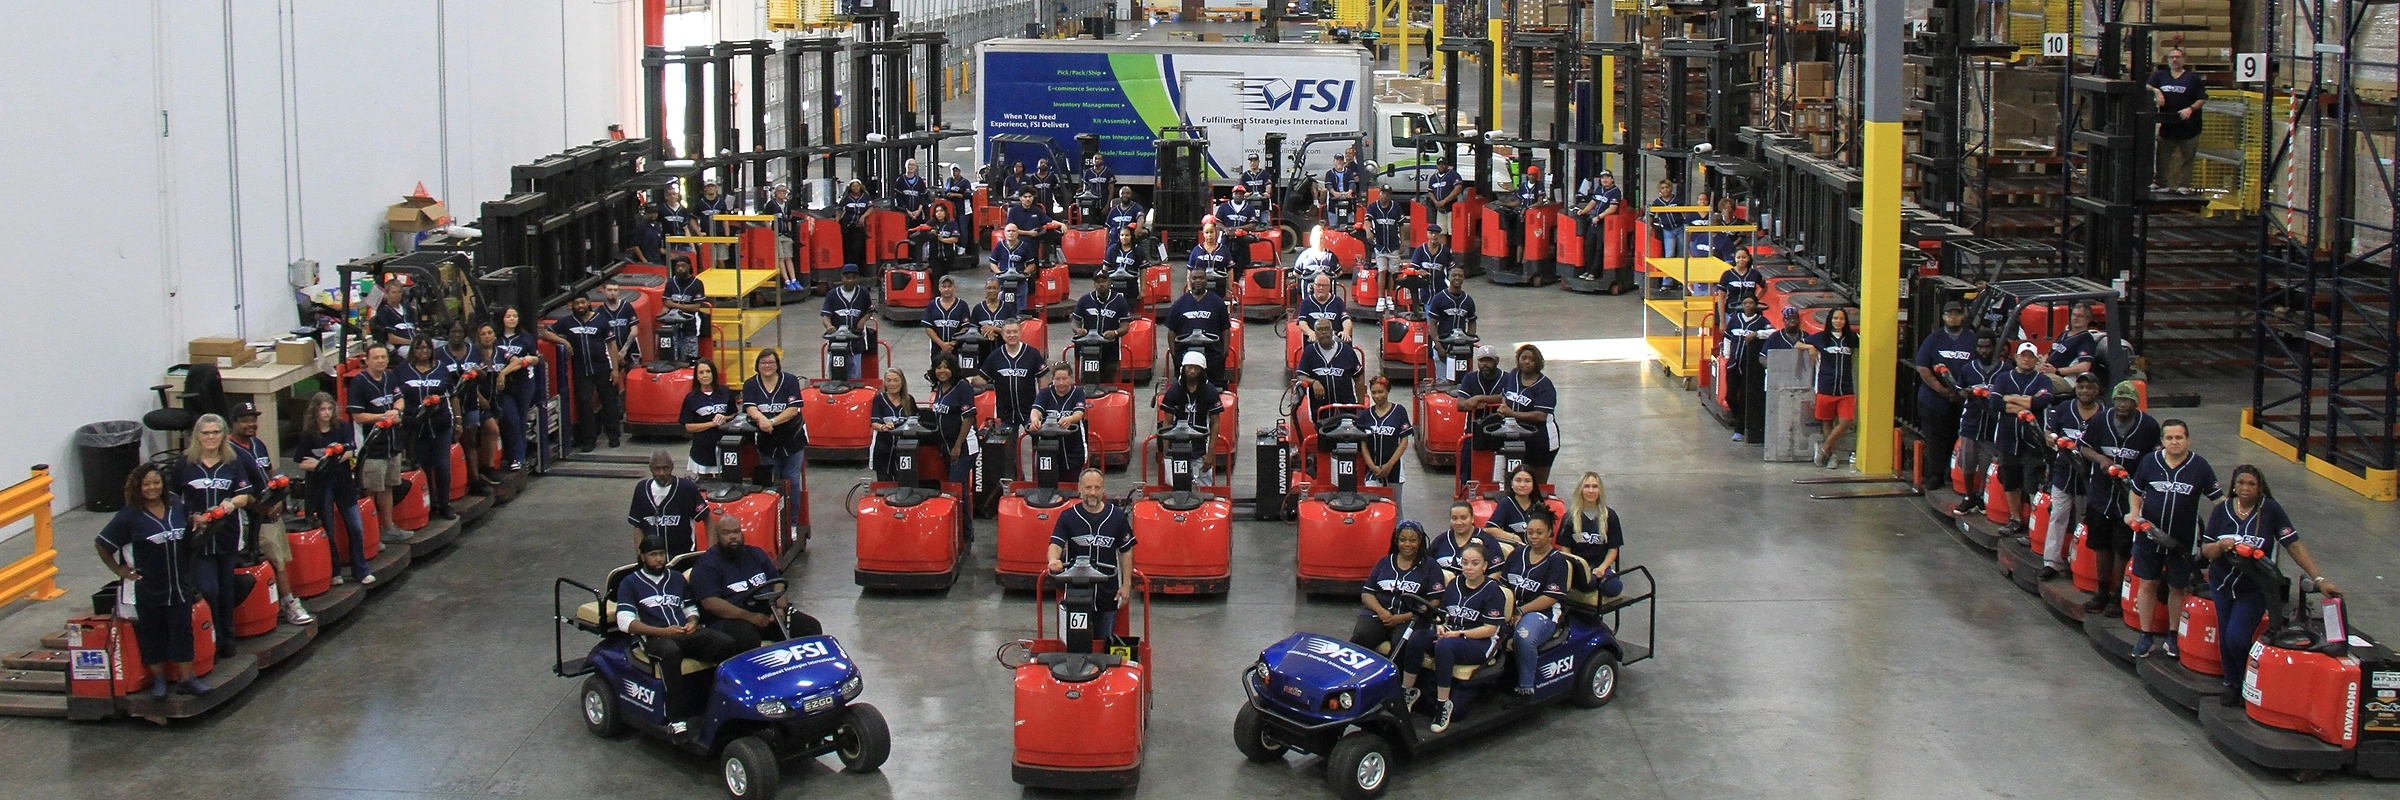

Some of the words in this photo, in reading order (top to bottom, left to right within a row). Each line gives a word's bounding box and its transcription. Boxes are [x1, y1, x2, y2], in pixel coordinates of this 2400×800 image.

[1754, 6, 1762, 16] 3
[1820, 13, 1832, 24] 12
[2047, 36, 2063, 52] 10
[2244, 56, 2256, 78] 9
[1289, 79, 1356, 112] FSI
[990, 120, 1029, 128] Experience,
[1249, 117, 1291, 126] Strategies
[1293, 118, 1348, 126] International
[1005, 293, 1014, 302] 60
[661, 338, 671, 348] 64
[833, 356, 844, 366] 68
[1954, 350, 1970, 360] FSI
[962, 358, 973, 368] T7
[1085, 360, 1099, 371] T10
[1456, 360, 1467, 370] T5
[1013, 368, 1028, 378] FSI
[1330, 368, 1344, 376] FSI
[1516, 394, 1532, 406] FSI
[770, 403, 786, 412] FSI
[1378, 426, 1396, 436] FSI
[724, 454, 737, 465] 62
[2120, 448, 2140, 460] FSI
[900, 457, 912, 469] 61
[1040, 457, 1051, 469] T1
[1175, 461, 1187, 473] T4
[1340, 461, 1352, 474] T6
[1279, 448, 1287, 495] RAYMOND
[211, 478, 232, 490] FSI
[2172, 482, 2194, 495] FSI
[660, 515, 680, 526] FSI
[170, 528, 186, 541] FS
[1094, 534, 1115, 548] FSI
[2242, 534, 2265, 548] FSI
[749, 572, 766, 586] FSI
[1520, 578, 1540, 592] FSI
[1398, 580, 1421, 594] FSI
[662, 594, 680, 606] FSI
[1460, 606, 1480, 621] FSI
[1070, 613, 1086, 628] 67
[789, 640, 828, 661] FSI
[1328, 647, 1376, 670] FSI
[1556, 654, 1574, 675] FSI
[757, 668, 785, 681] Fulfillment
[784, 662, 808, 672] Strategies
[807, 656, 836, 666] International
[638, 686, 655, 705] FSI
[2343, 682, 2357, 740] RAYMOND
